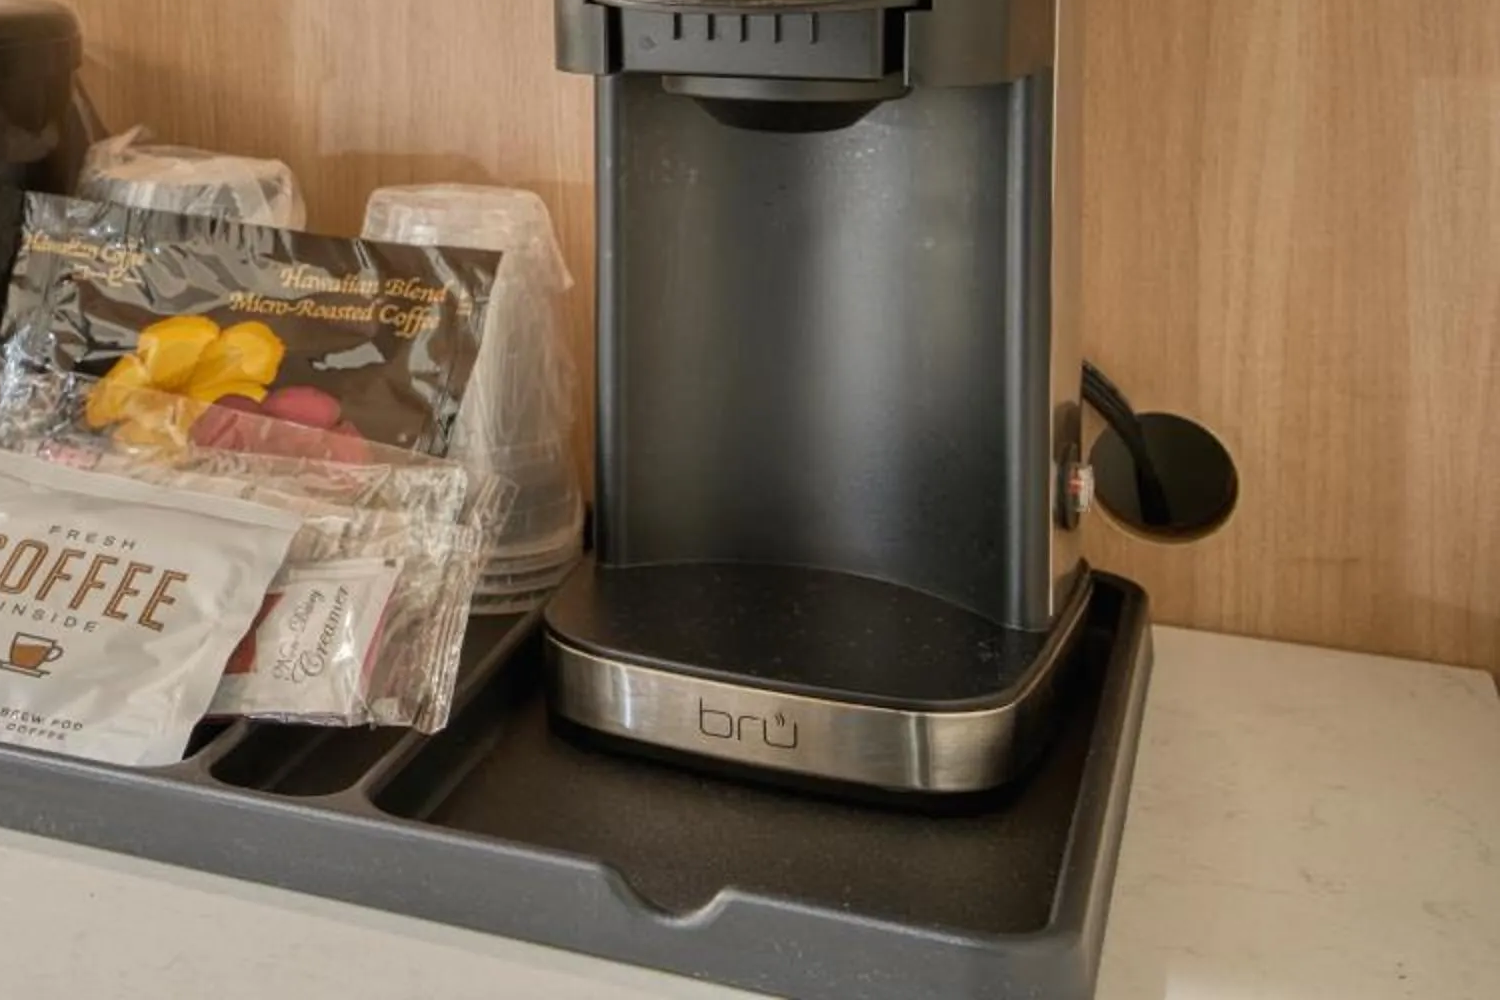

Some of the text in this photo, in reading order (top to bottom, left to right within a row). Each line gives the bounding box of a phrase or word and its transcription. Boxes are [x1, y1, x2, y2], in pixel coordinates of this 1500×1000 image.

[279, 264, 379, 295] Hawaiian
[385, 277, 449, 304] Blend
[228, 292, 378, 323] Micro-Roasted
[378, 302, 441, 338] Coffee
[48, 525, 137, 550] FRESH
[0, 706, 43, 725] BREW
[51, 718, 83, 731] POD
